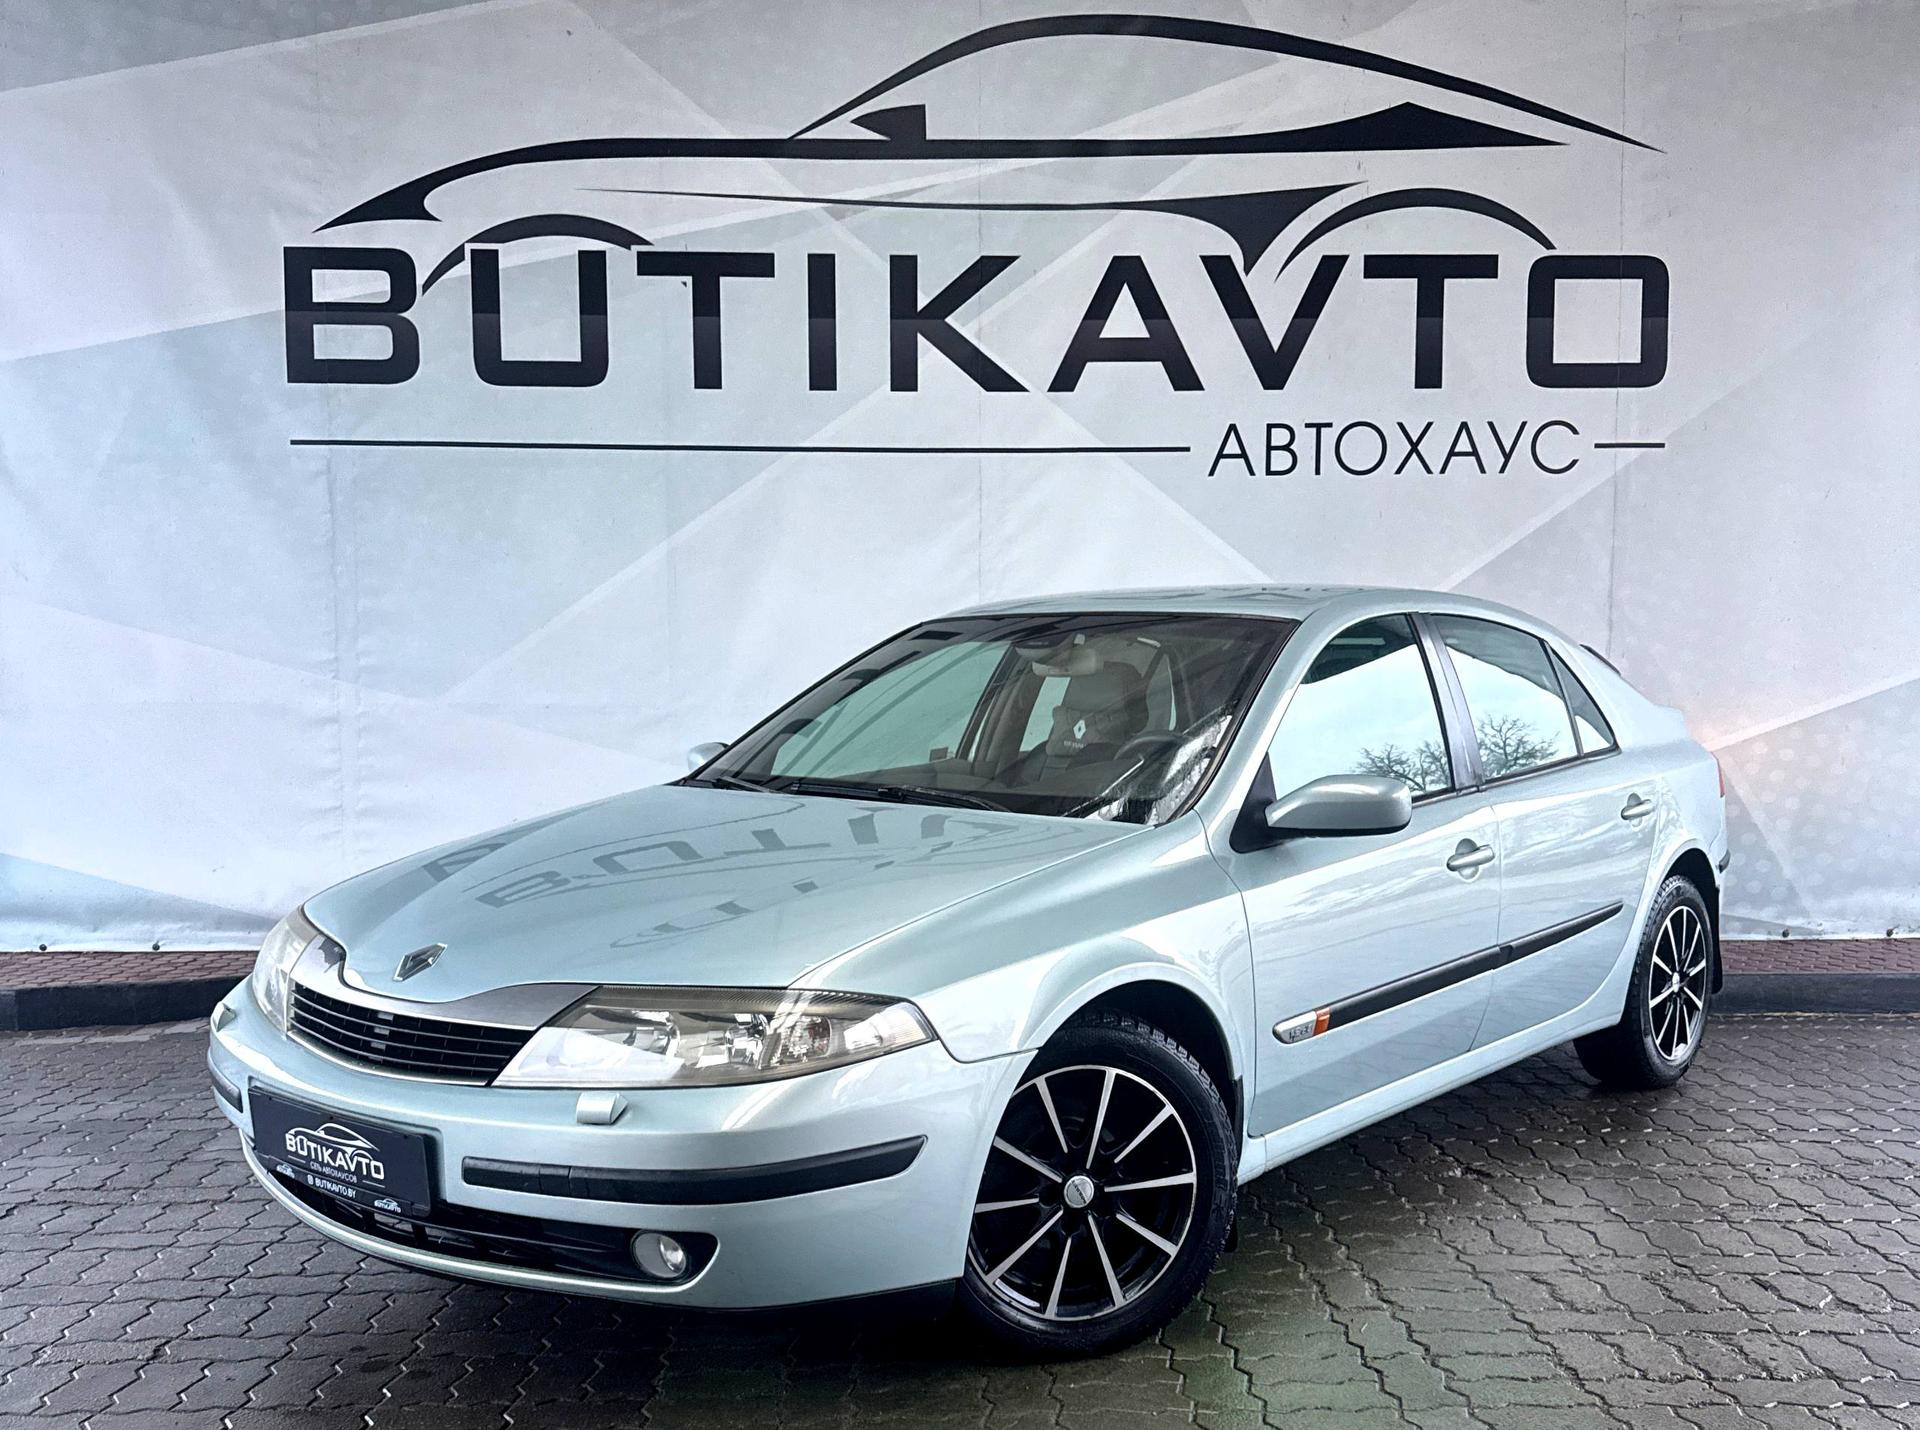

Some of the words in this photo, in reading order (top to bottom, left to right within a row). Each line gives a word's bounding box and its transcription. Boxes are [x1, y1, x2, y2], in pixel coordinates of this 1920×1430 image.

[283, 246, 1670, 392] BUTIKAVTO
[1207, 419, 1581, 477] АВТОХАУС
[285, 1133, 385, 1180] BUTIKAVTO
